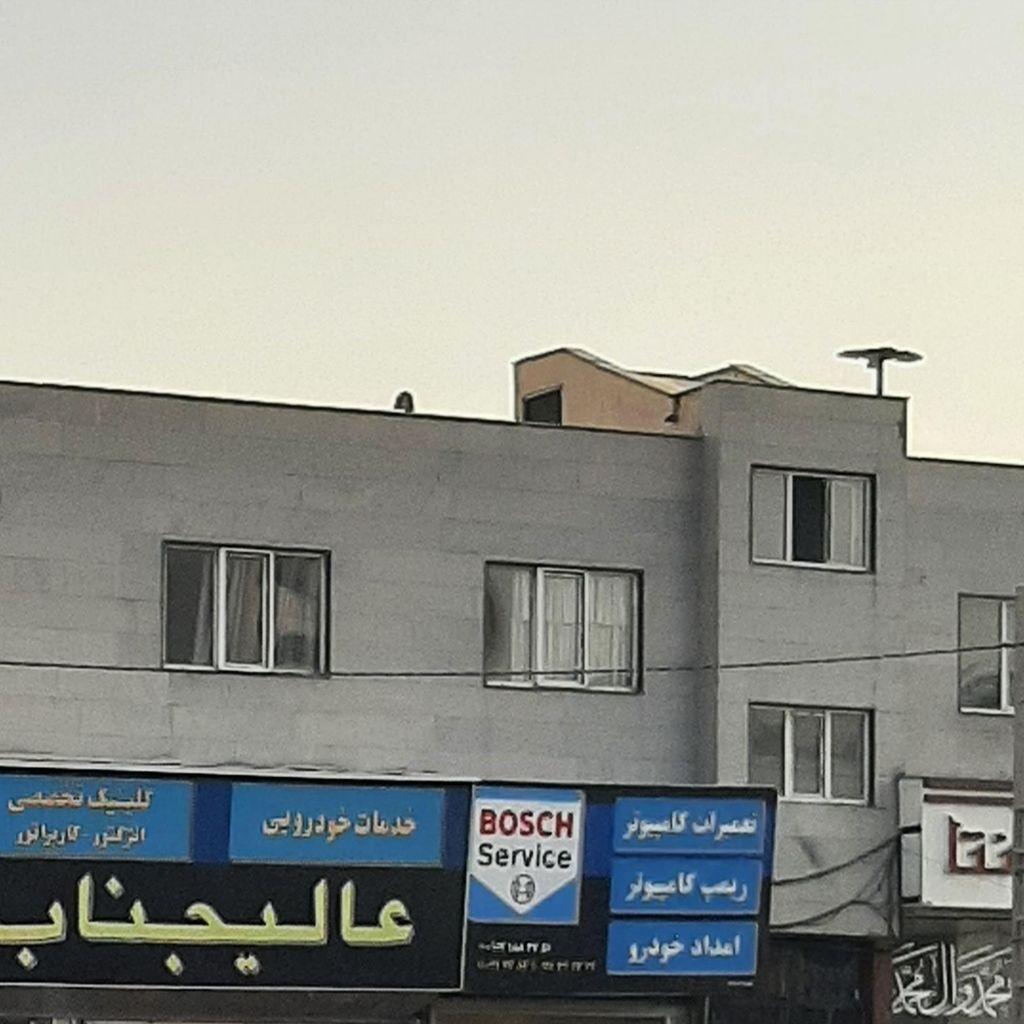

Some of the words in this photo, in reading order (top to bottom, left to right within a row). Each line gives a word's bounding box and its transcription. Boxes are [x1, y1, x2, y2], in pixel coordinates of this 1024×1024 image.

[262, 807, 352, 843] خودرویی
[354, 807, 417, 838] خدمات
[479, 808, 574, 839] BOSCH
[622, 809, 689, 840] کامپیوتر
[691, 809, 758, 841] تعمیرات
[477, 843, 573, 870] Service
[627, 932, 685, 964] خودرو
[690, 933, 741, 957] امداد
